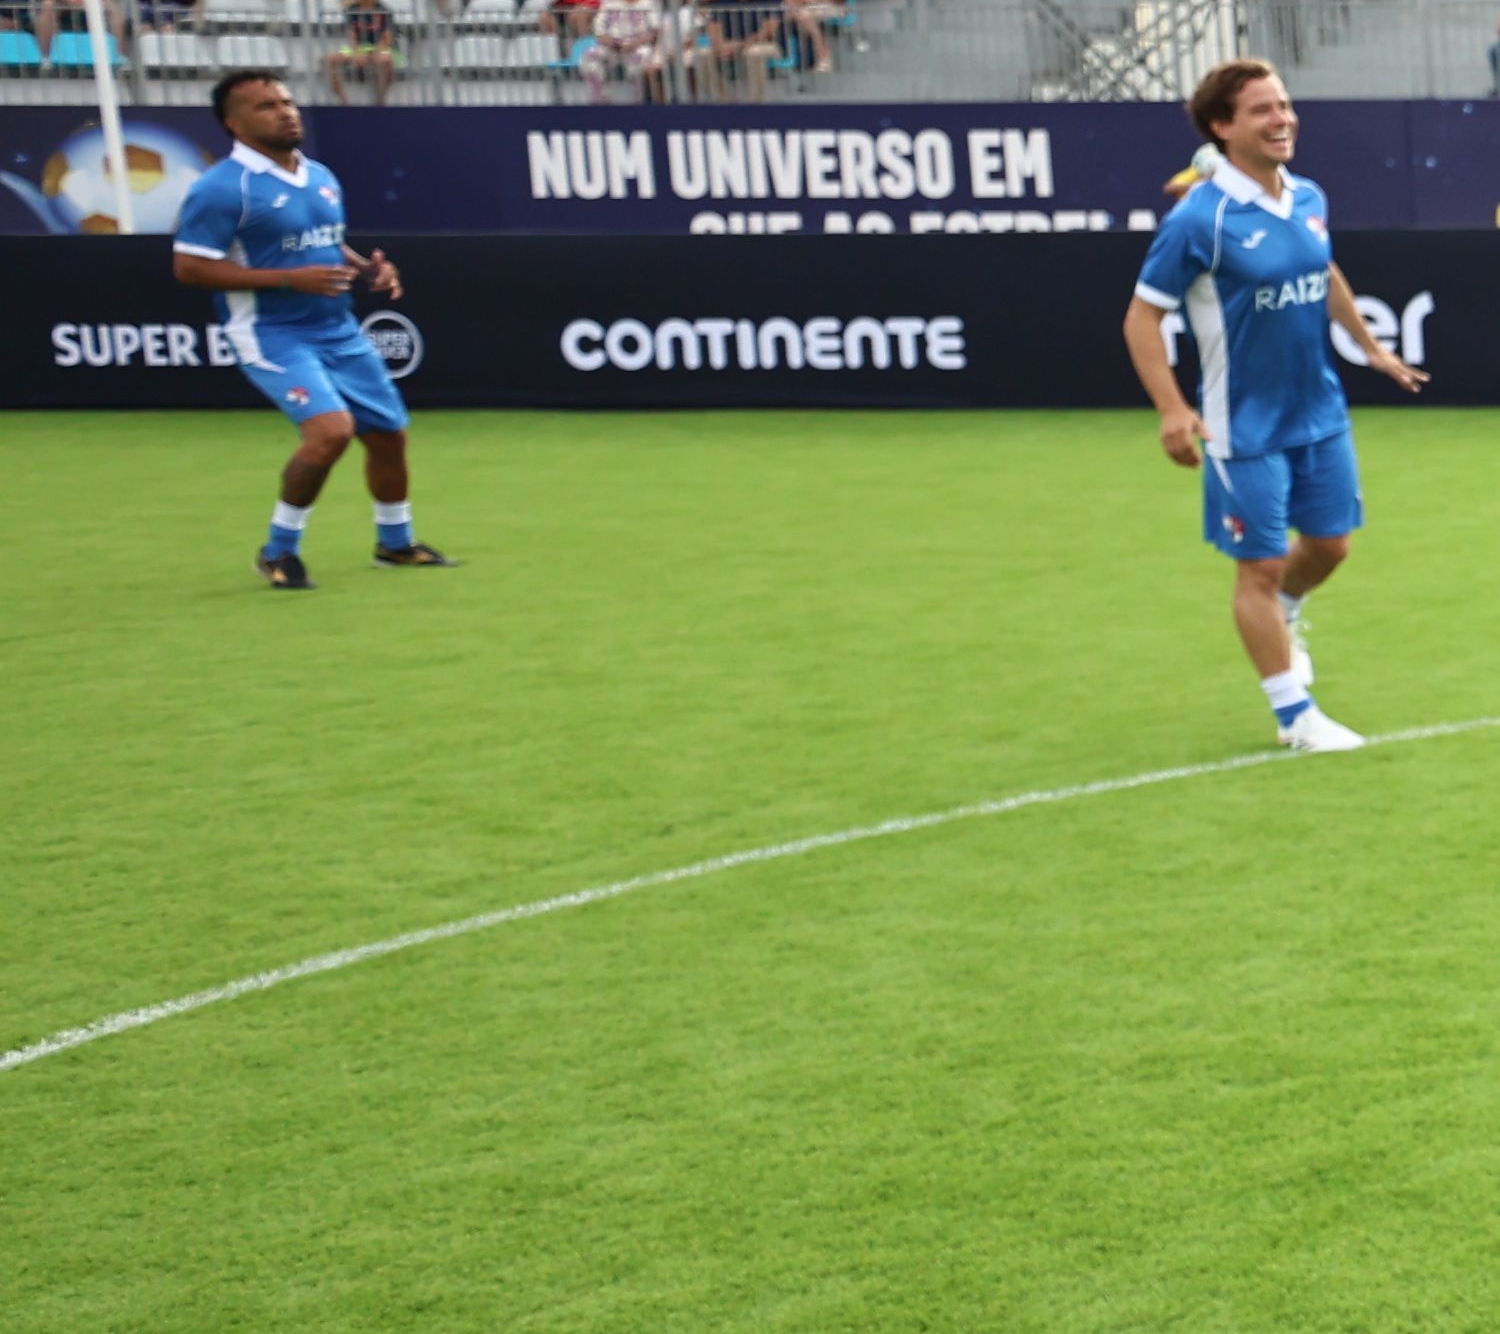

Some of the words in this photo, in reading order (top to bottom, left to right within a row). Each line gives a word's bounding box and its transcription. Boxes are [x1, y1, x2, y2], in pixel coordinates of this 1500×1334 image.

[527, 130, 657, 200] NUM
[667, 129, 956, 200] UNIVERSO
[967, 128, 1055, 199] EM
[1255, 270, 1329, 311] RAIZ
[52, 322, 200, 369] SUPER
[560, 315, 966, 372] CONTINENTE
